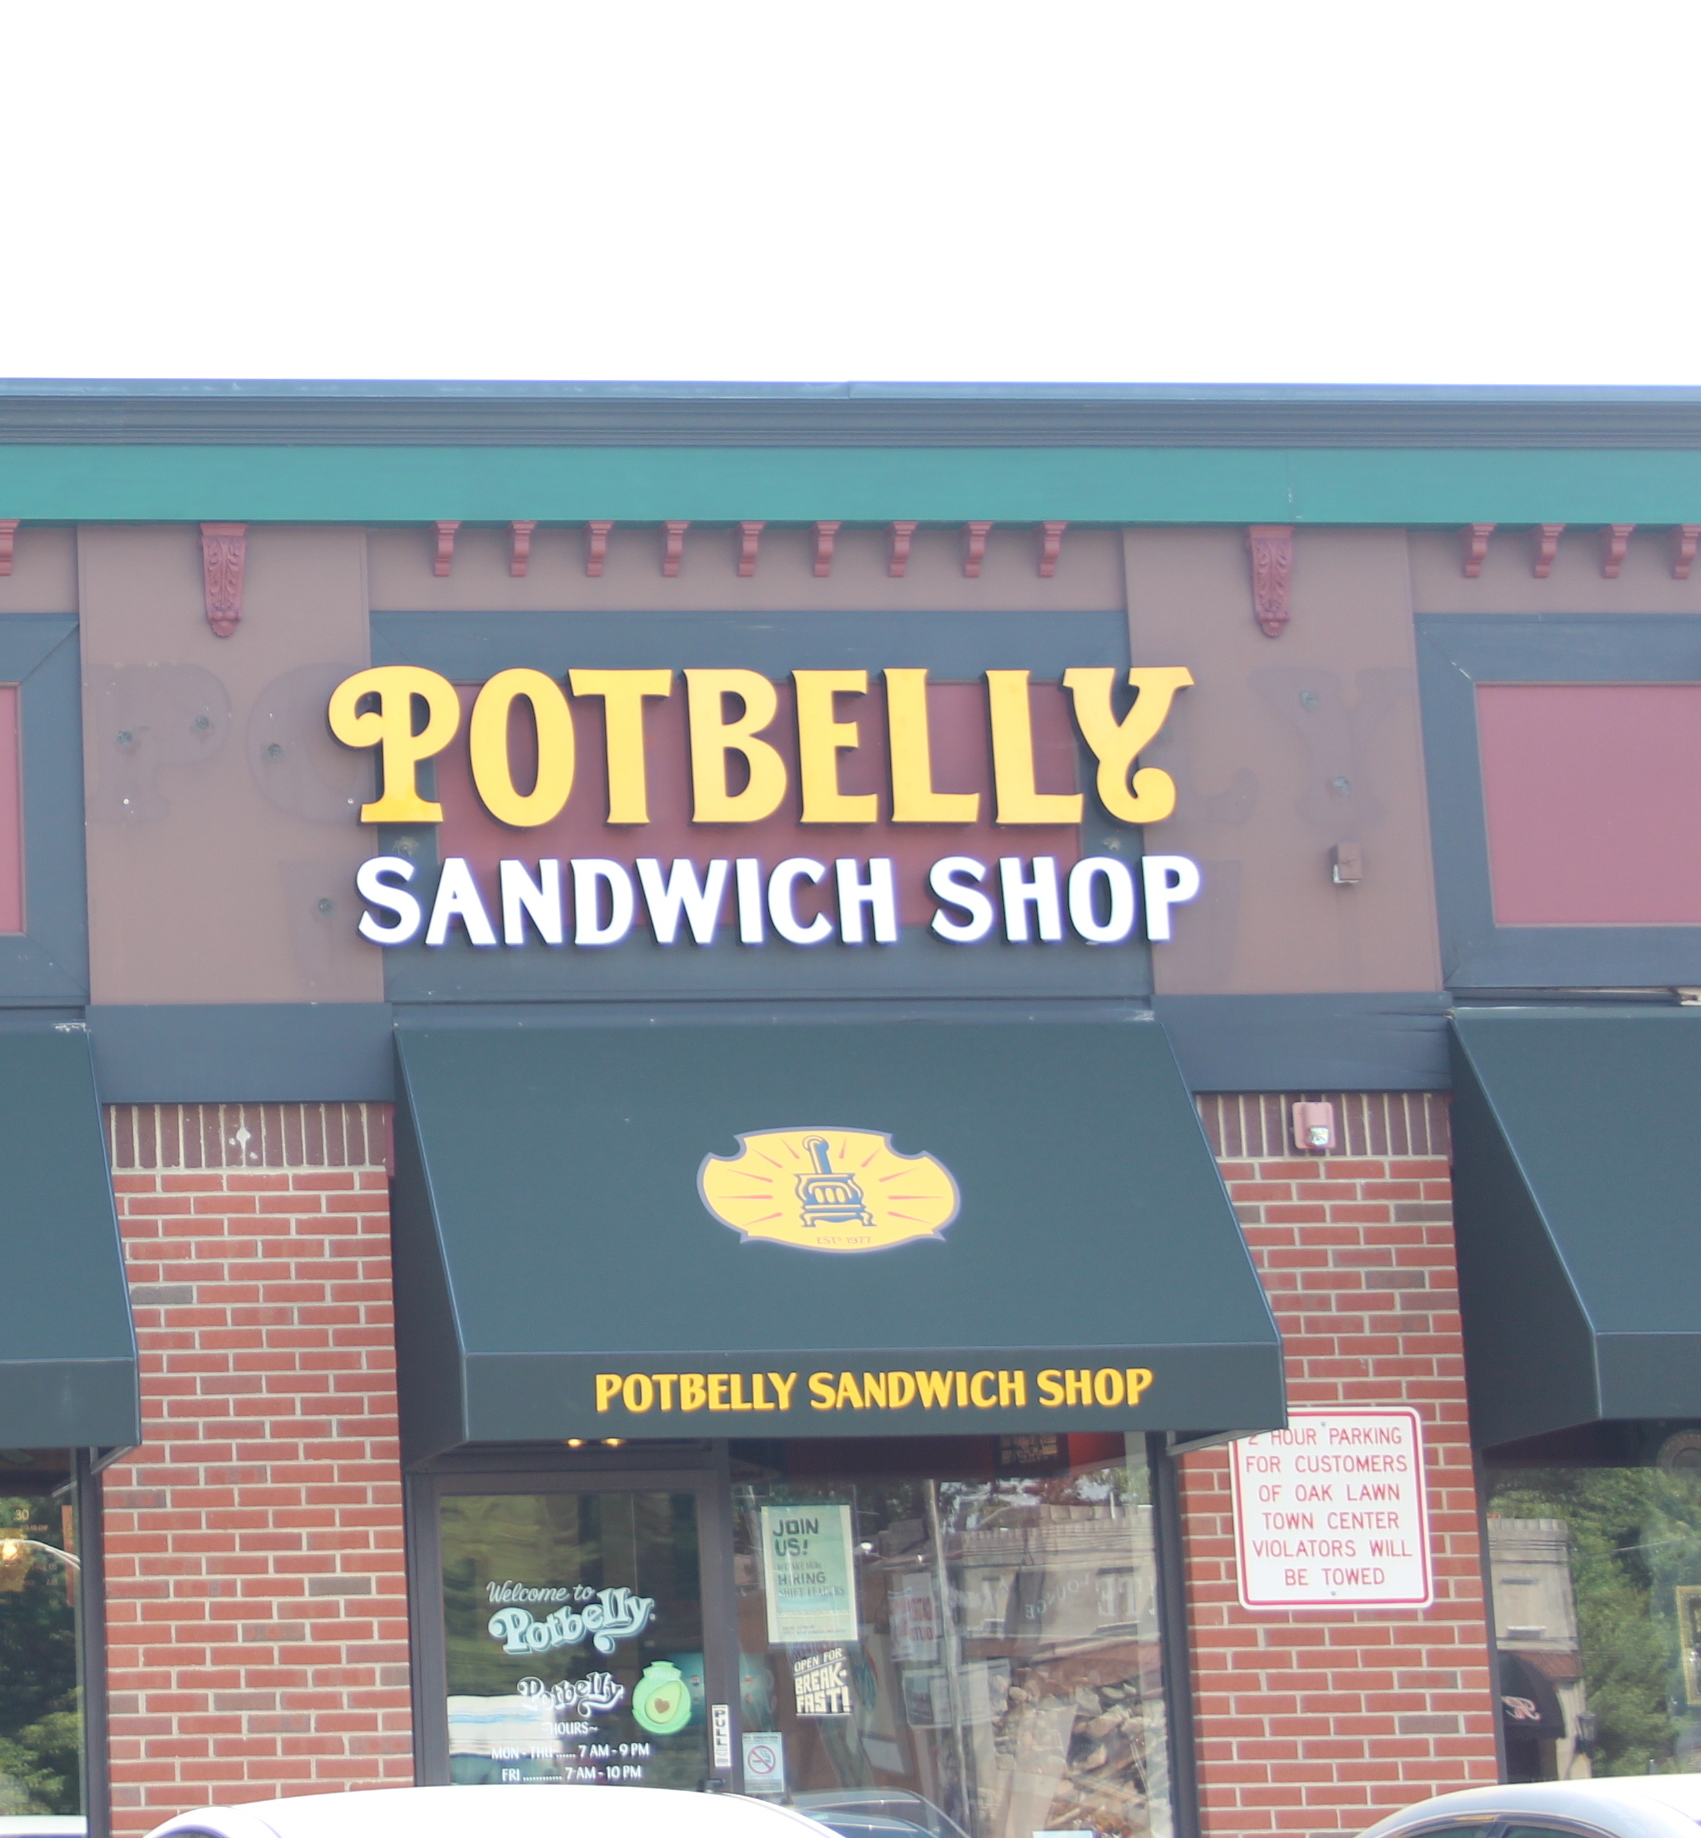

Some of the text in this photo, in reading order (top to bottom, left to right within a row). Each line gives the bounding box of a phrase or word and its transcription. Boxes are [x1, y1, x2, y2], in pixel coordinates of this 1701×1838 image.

[328, 665, 1195, 828] POTBELLY
[356, 854, 1201, 947] SANDWICH SHOP
[847, 1236, 871, 1244] 1977
[595, 1367, 1154, 1412] POTBELLY SANDWICH SHOP
[1270, 1428, 1317, 1445] HOUR
[1329, 1427, 1402, 1445] PARKING
[1246, 1455, 1408, 1473] FOR CUSTOMERS
[1258, 1484, 1401, 1502] OF OAK LAWN
[772, 1518, 819, 1536] JOIN
[1262, 1511, 1399, 1530] TOWN CENTER
[775, 1538, 808, 1557] US!
[1252, 1539, 1412, 1557] VIOLATORS WILL
[778, 1571, 826, 1586] HIRING
[1284, 1567, 1385, 1586] BE TOWED
[486, 1580, 596, 1602] Welcome to
[778, 1585, 845, 1598] SHIFT LEADERS
[488, 1587, 655, 1655] Potbelly
[794, 1647, 843, 1672] OPEN FOR
[795, 1662, 847, 1695] BREAK-
[517, 1671, 625, 1718] Potbelly
[796, 1686, 850, 1713] FAST!
[714, 1709, 727, 1746] PULL
[491, 1747, 519, 1760] MON
[531, 1746, 553, 1759] THU
[578, 1745, 587, 1758] 7
[590, 1744, 609, 1757] AM
[619, 1743, 628, 1757] 9
[631, 1743, 650, 1756] PM
[502, 1768, 521, 1781] FRI
[565, 1767, 573, 1780] 7
[576, 1766, 596, 1779] AM
[606, 1765, 620, 1778] 10
[623, 1764, 642, 1778] PM
